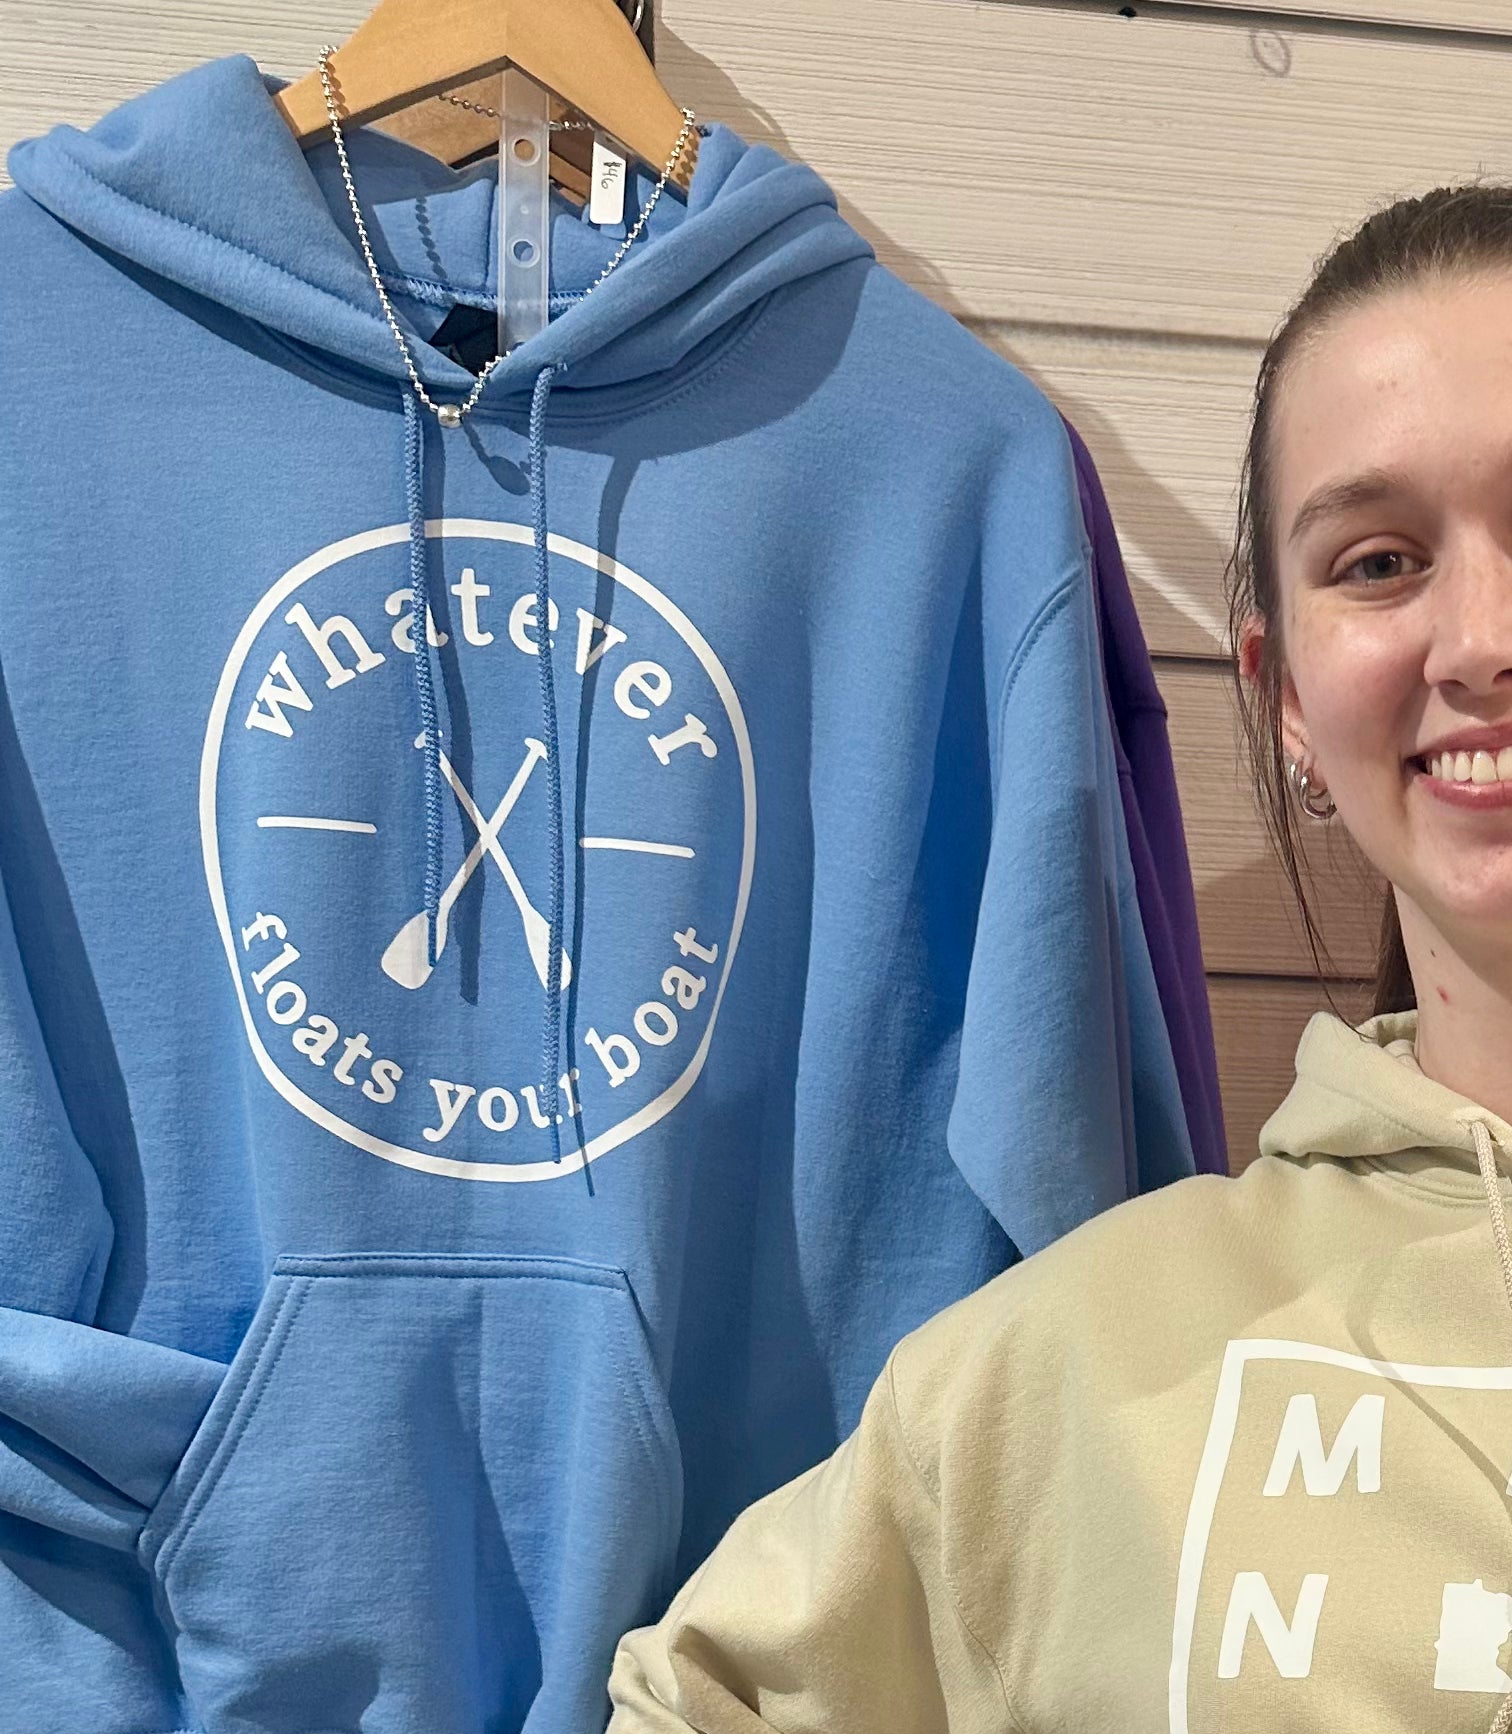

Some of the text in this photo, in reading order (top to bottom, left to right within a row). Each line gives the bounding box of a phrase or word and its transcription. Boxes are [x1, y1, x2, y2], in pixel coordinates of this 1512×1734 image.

[244, 567, 718, 766] whatever
[241, 911, 404, 1104] floats
[583, 926, 719, 1089] boat
